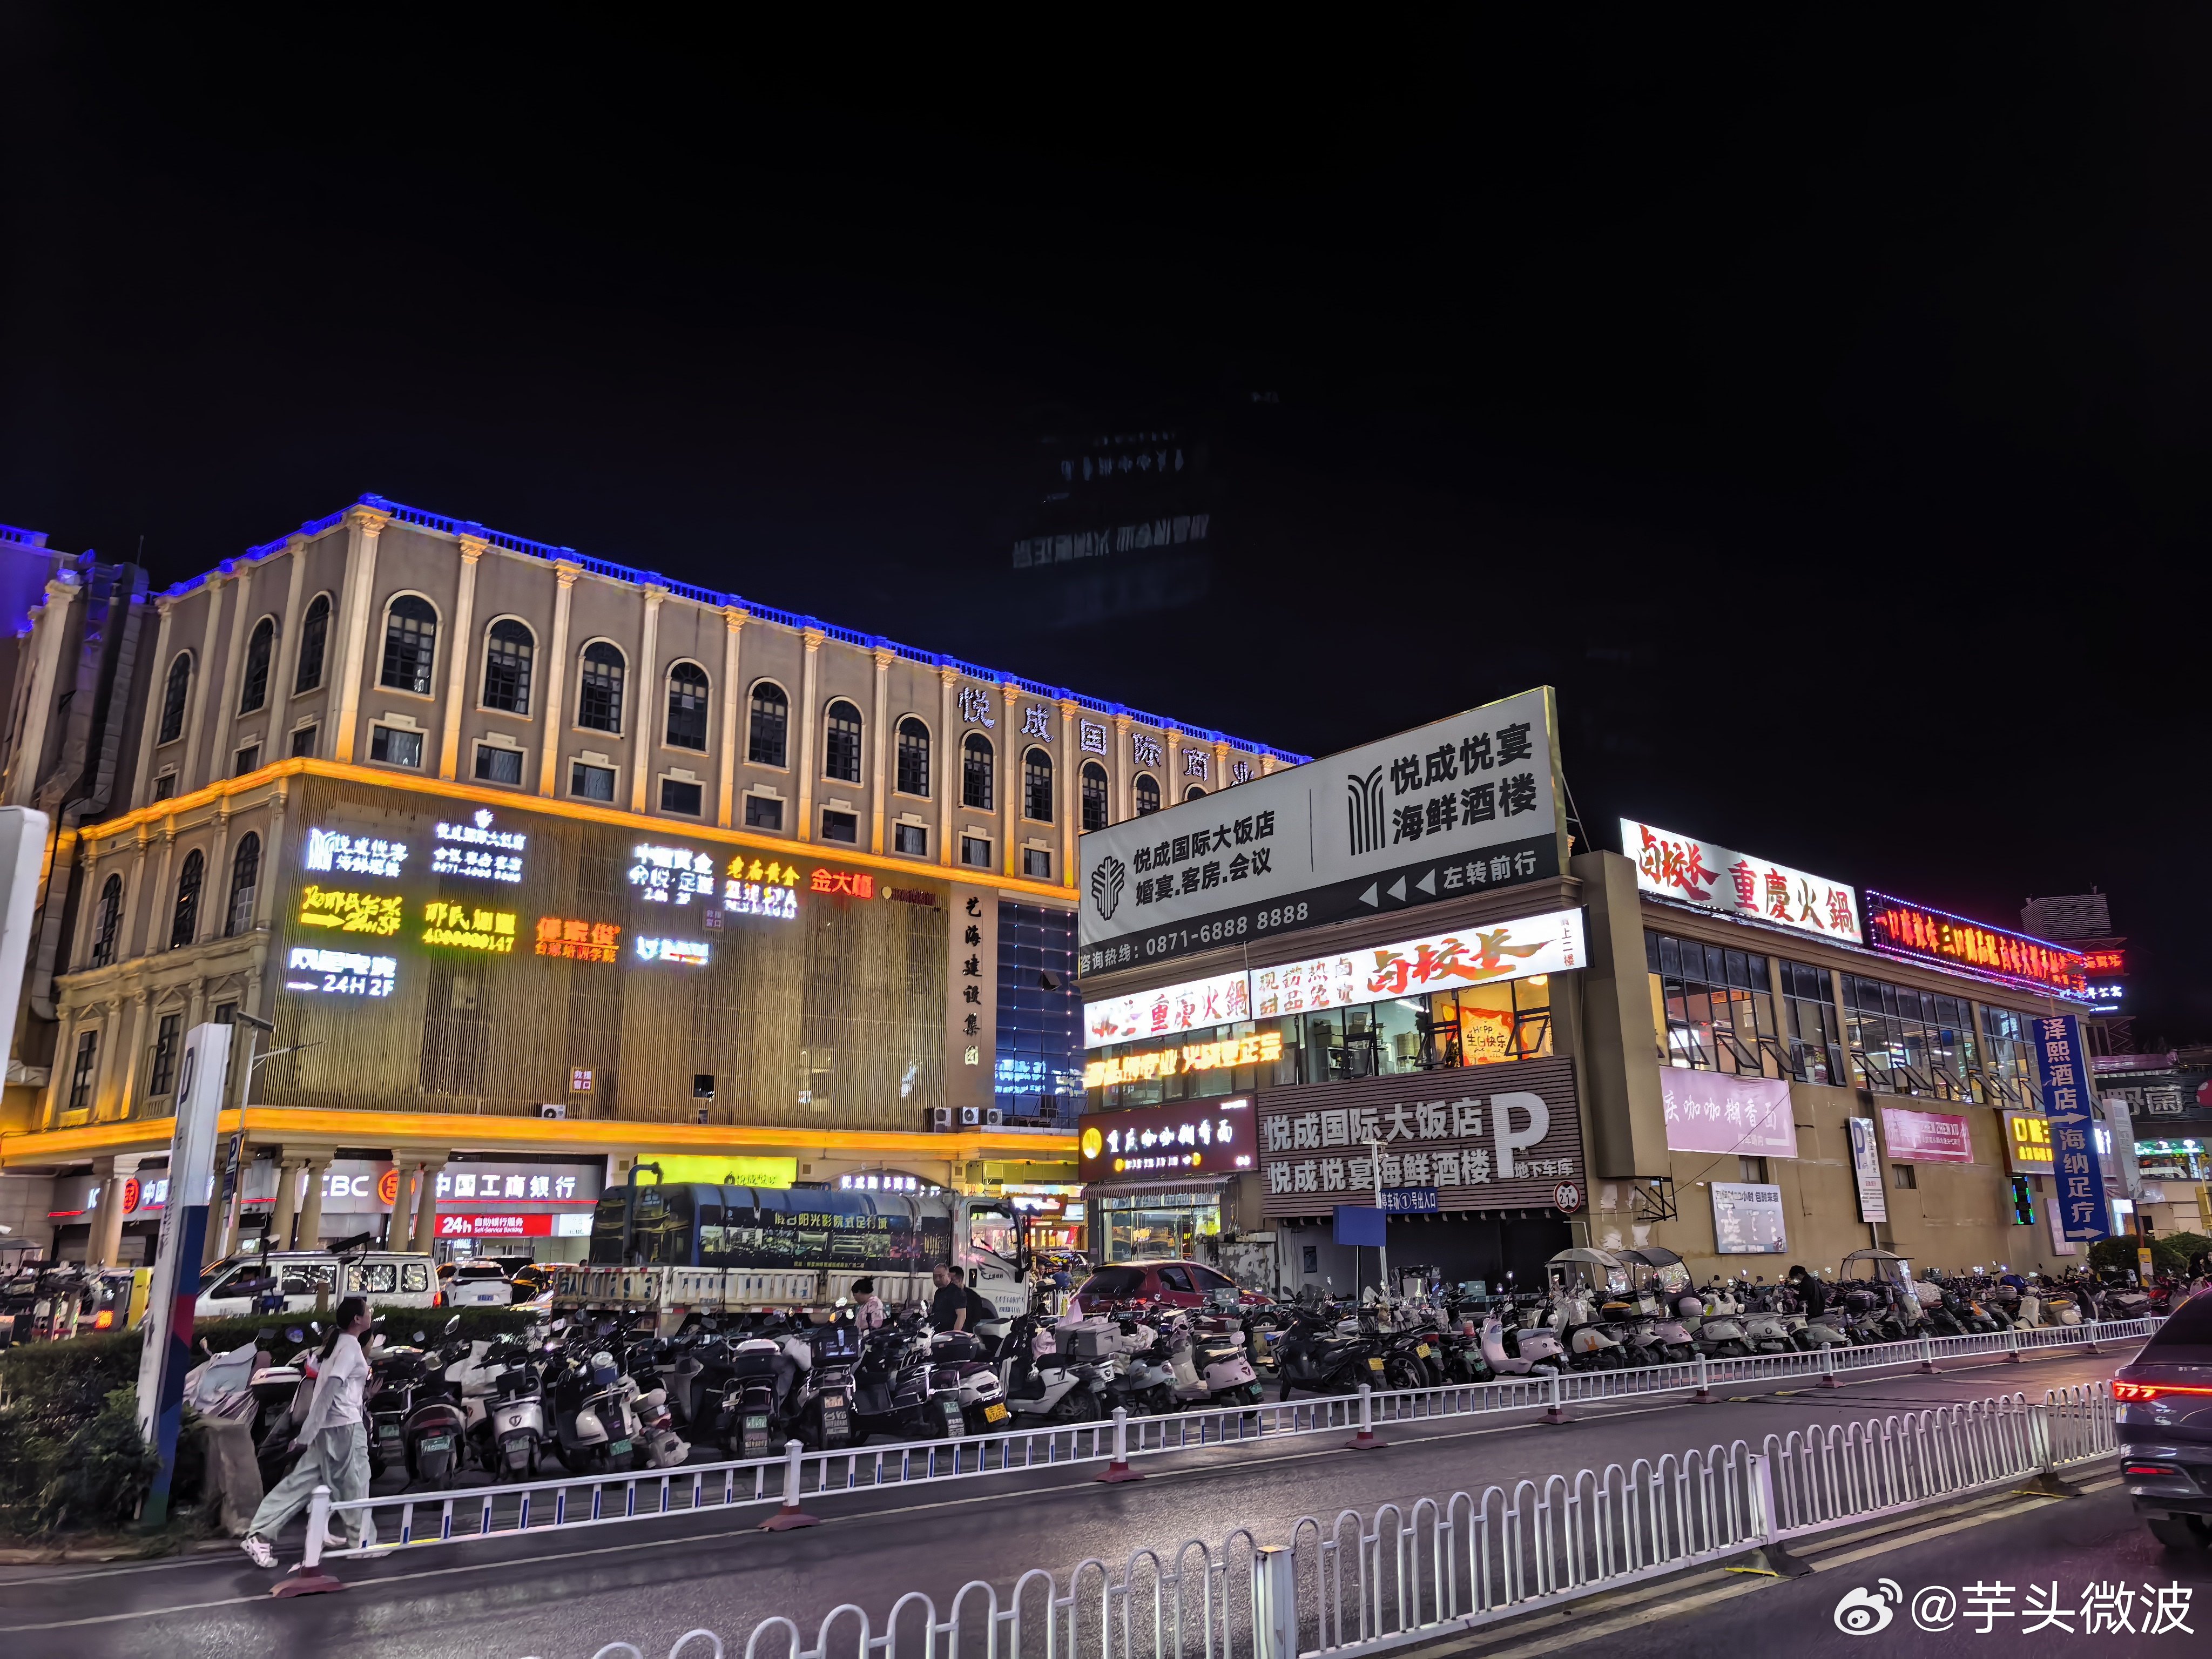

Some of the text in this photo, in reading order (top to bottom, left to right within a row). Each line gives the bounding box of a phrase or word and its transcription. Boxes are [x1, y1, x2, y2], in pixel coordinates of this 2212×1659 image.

[1390, 723, 1532, 795] 悦成悦宴
[1392, 772, 1537, 844] 海鲜酒楼
[1134, 810, 1275, 874] 悦成国际大饭店
[1444, 850, 1536, 890] 左转前行
[1136, 847, 1272, 907] 婚宴.客房.会议
[1728, 859, 1856, 933] 重慶火鍋
[1146, 916, 1247, 955] 0871-6888
[1257, 902, 1309, 930] 8888
[323, 974, 395, 996] 24H 2F
[963, 896, 982, 1065] 艺海建设集团
[1367, 928, 1557, 994] 卤校长
[1466, 1033, 1508, 1048] 生日快乐
[2042, 1019, 2078, 1110] 泽熙酒店
[1264, 1098, 1483, 1151] 悦成国际大饭店
[1491, 1092, 1550, 1179] P
[436, 1174, 576, 1198] 中国工商银行
[1267, 1149, 1492, 1194] 悦成悦宴海鲜酒楼
[1514, 1158, 1574, 1178] 地下车库
[2060, 1129, 2095, 1223] 海纳足疗
[442, 1216, 472, 1233] 24h
